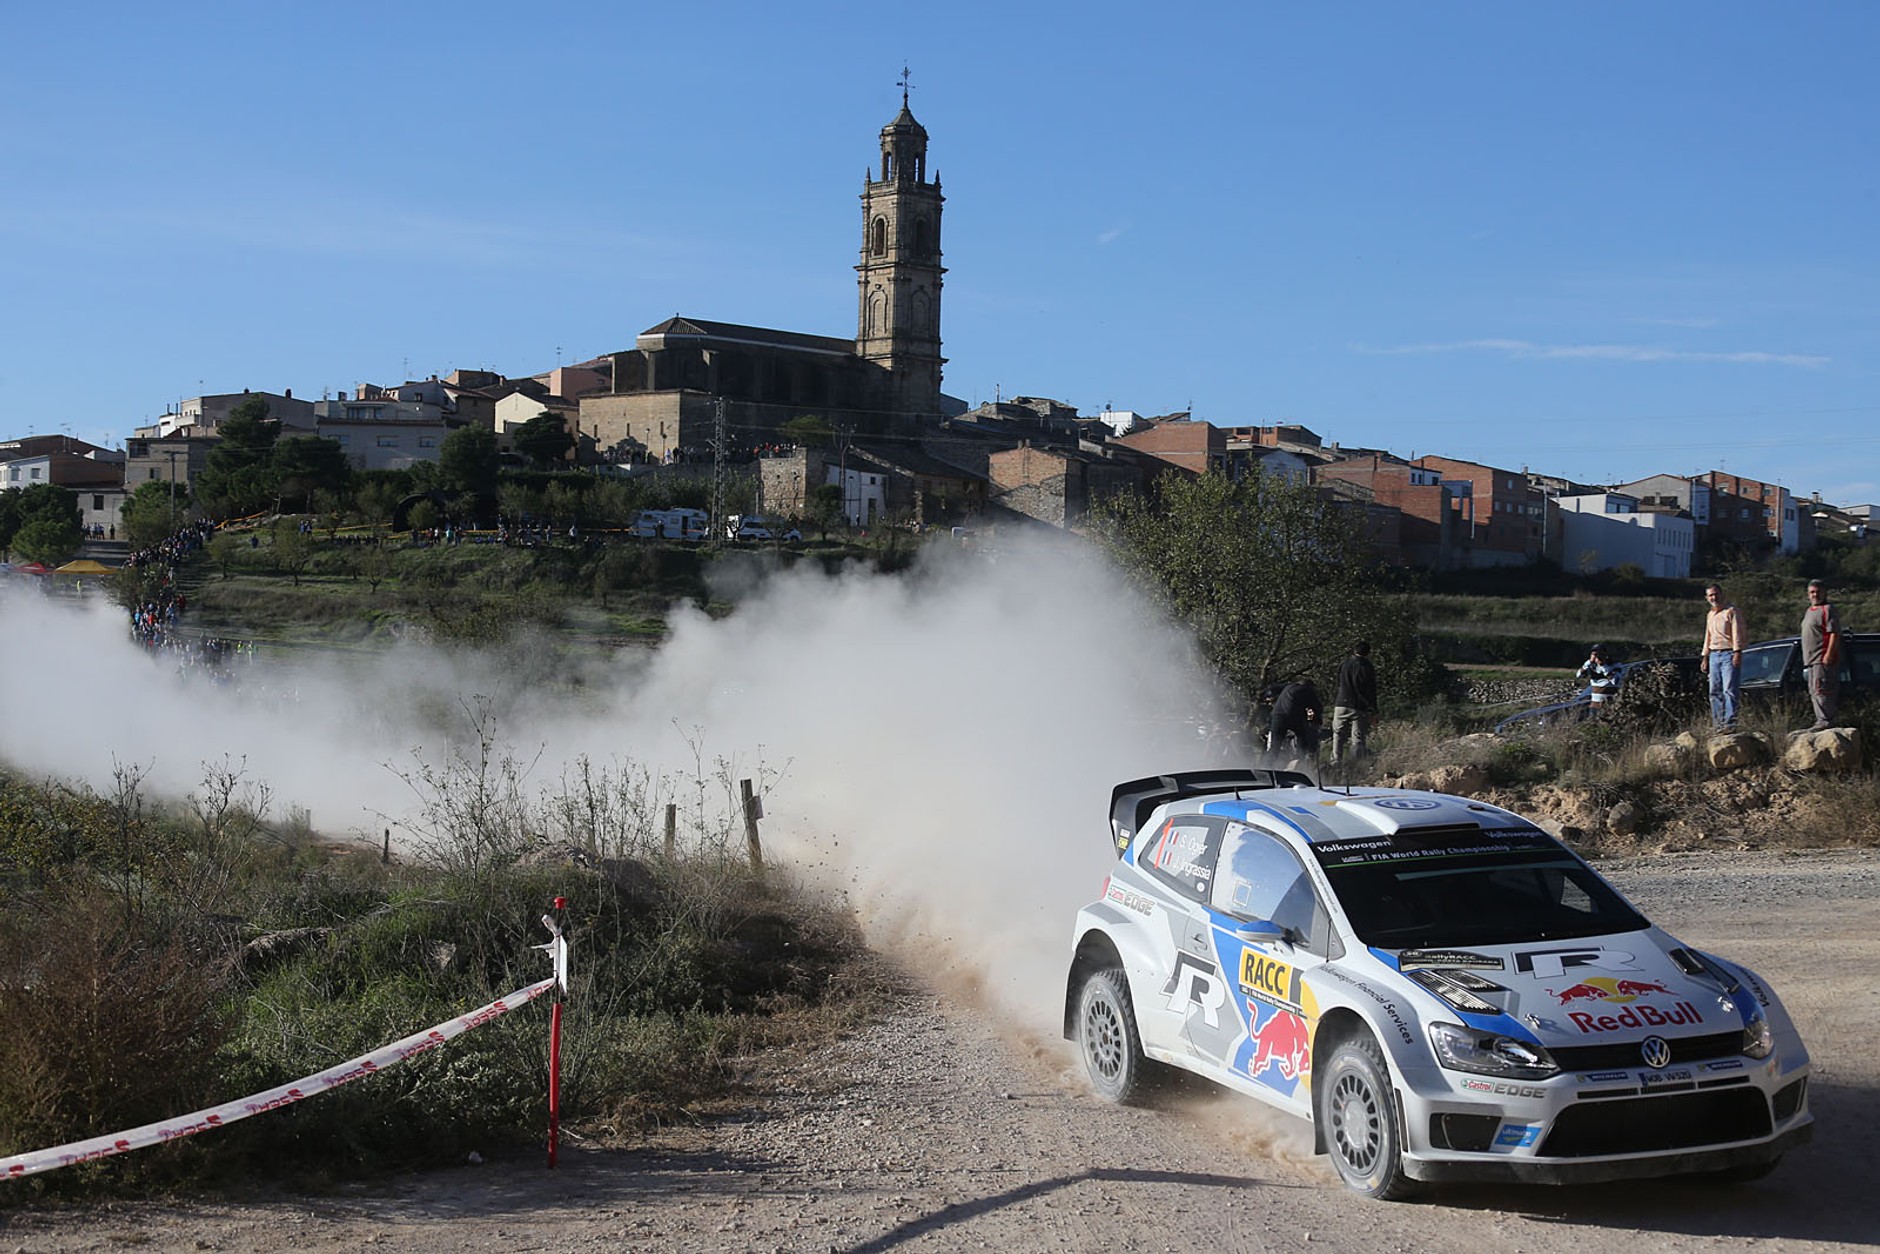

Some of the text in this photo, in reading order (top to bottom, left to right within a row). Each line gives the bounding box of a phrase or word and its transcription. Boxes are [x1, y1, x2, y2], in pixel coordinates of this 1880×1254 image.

[1317, 840, 1391, 853] Volkswagen
[1372, 853, 1390, 861] FIA
[1390, 850, 1420, 859] World
[1421, 848, 1446, 857] Rally
[1447, 845, 1510, 855] Championship
[1244, 953, 1286, 996] RACC
[1354, 980, 1386, 1005] Financial
[1383, 1001, 1414, 1046] Services
[1568, 1001, 1703, 1034] Red Bull
[1468, 1081, 1548, 1098] Castrol EDGE
